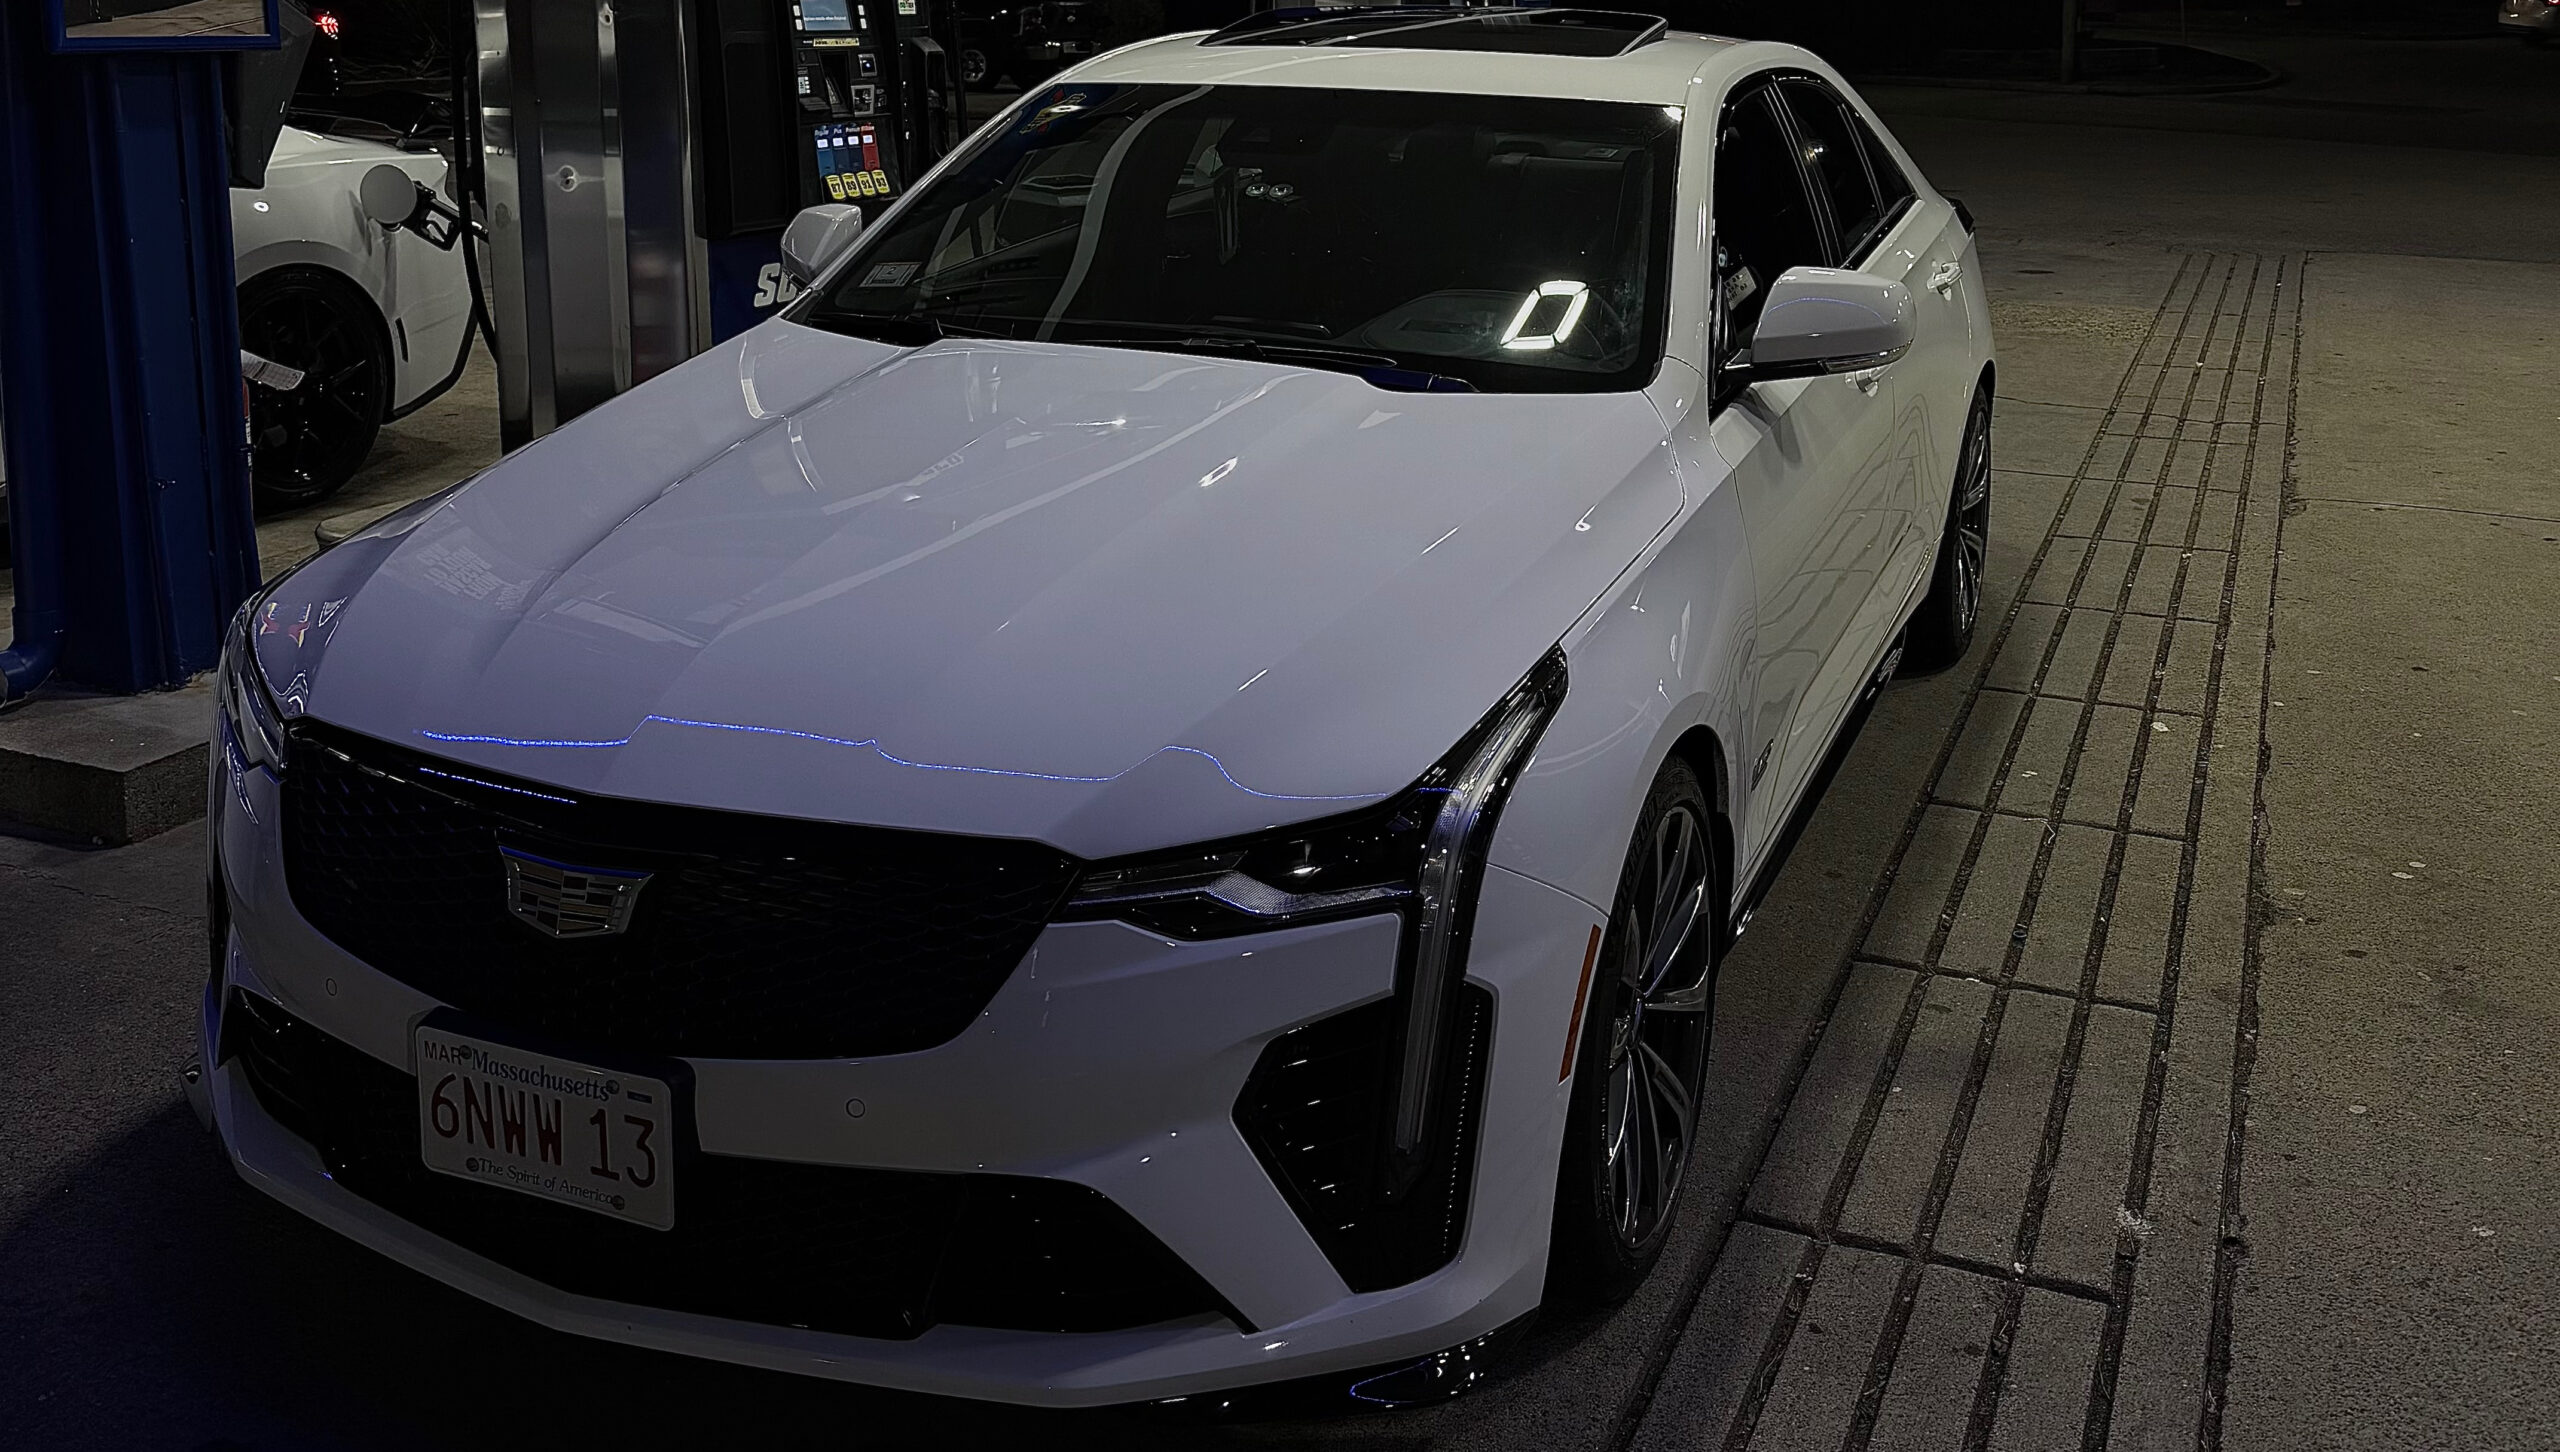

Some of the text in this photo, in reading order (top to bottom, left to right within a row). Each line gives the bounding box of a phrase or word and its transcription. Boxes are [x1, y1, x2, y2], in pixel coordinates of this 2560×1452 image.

[830, 182, 842, 194] 87
[846, 180, 858, 191] 89
[861, 178, 873, 190] 91
[876, 177, 888, 188] 93
[424, 1041, 462, 1065] MAR
[472, 1048, 610, 1101] Massachusetts
[431, 1074, 655, 1188] 6NWW 13
[478, 1158, 614, 1205] The Spirit of America
